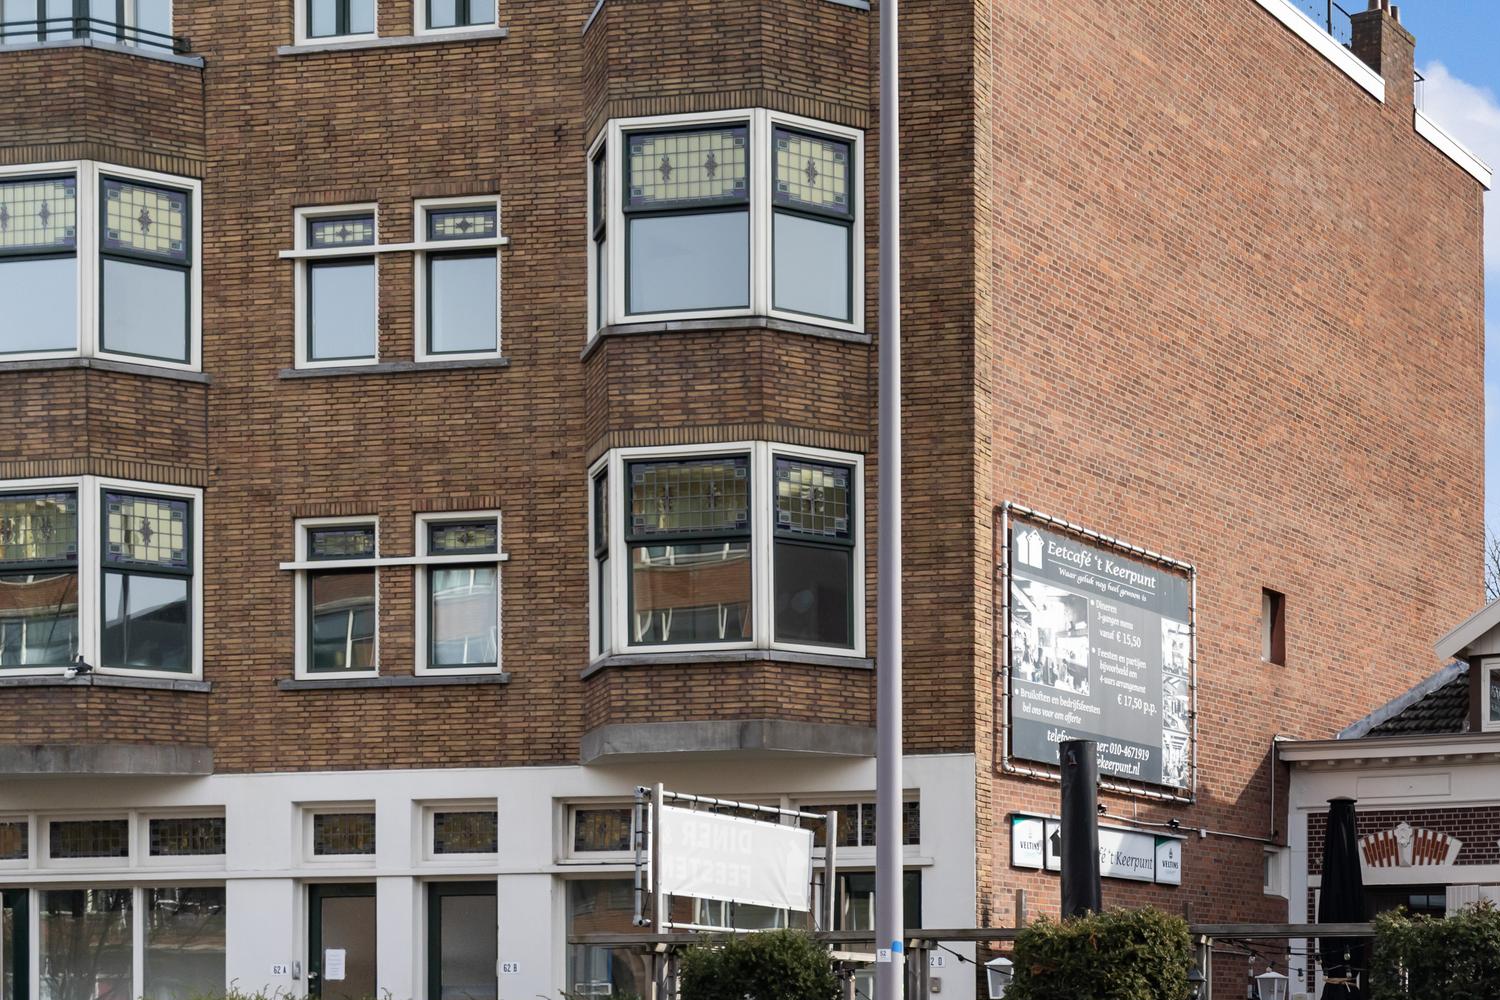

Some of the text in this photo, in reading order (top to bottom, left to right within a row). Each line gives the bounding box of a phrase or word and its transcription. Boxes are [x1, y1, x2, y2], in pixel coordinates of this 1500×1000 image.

[1047, 540, 1092, 567] Eetcafé
[1104, 560, 1157, 589] Keerpunt
[1058, 568, 1077, 580] Waar
[1095, 581, 1107, 592] nog
[1116, 631, 1122, 642] €
[1122, 632, 1142, 649] 15,50
[1097, 648, 1119, 661] Feesten
[1118, 655, 1126, 664] en
[1020, 687, 1101, 715] Bruiloften en bedrijfsfeesten
[1022, 701, 1032, 713] bel
[1041, 708, 1054, 719] voor
[1117, 693, 1123, 706] €
[1123, 695, 1143, 710] 17,50
[1109, 742, 1150, 761] 010-4671919
[1020, 841, 1040, 850] VELTINS
[1116, 851, 1153, 871] Keerpunt
[1162, 860, 1179, 870] VELTINS
[273, 965, 281, 974] 62
[503, 963, 511, 973] 62
